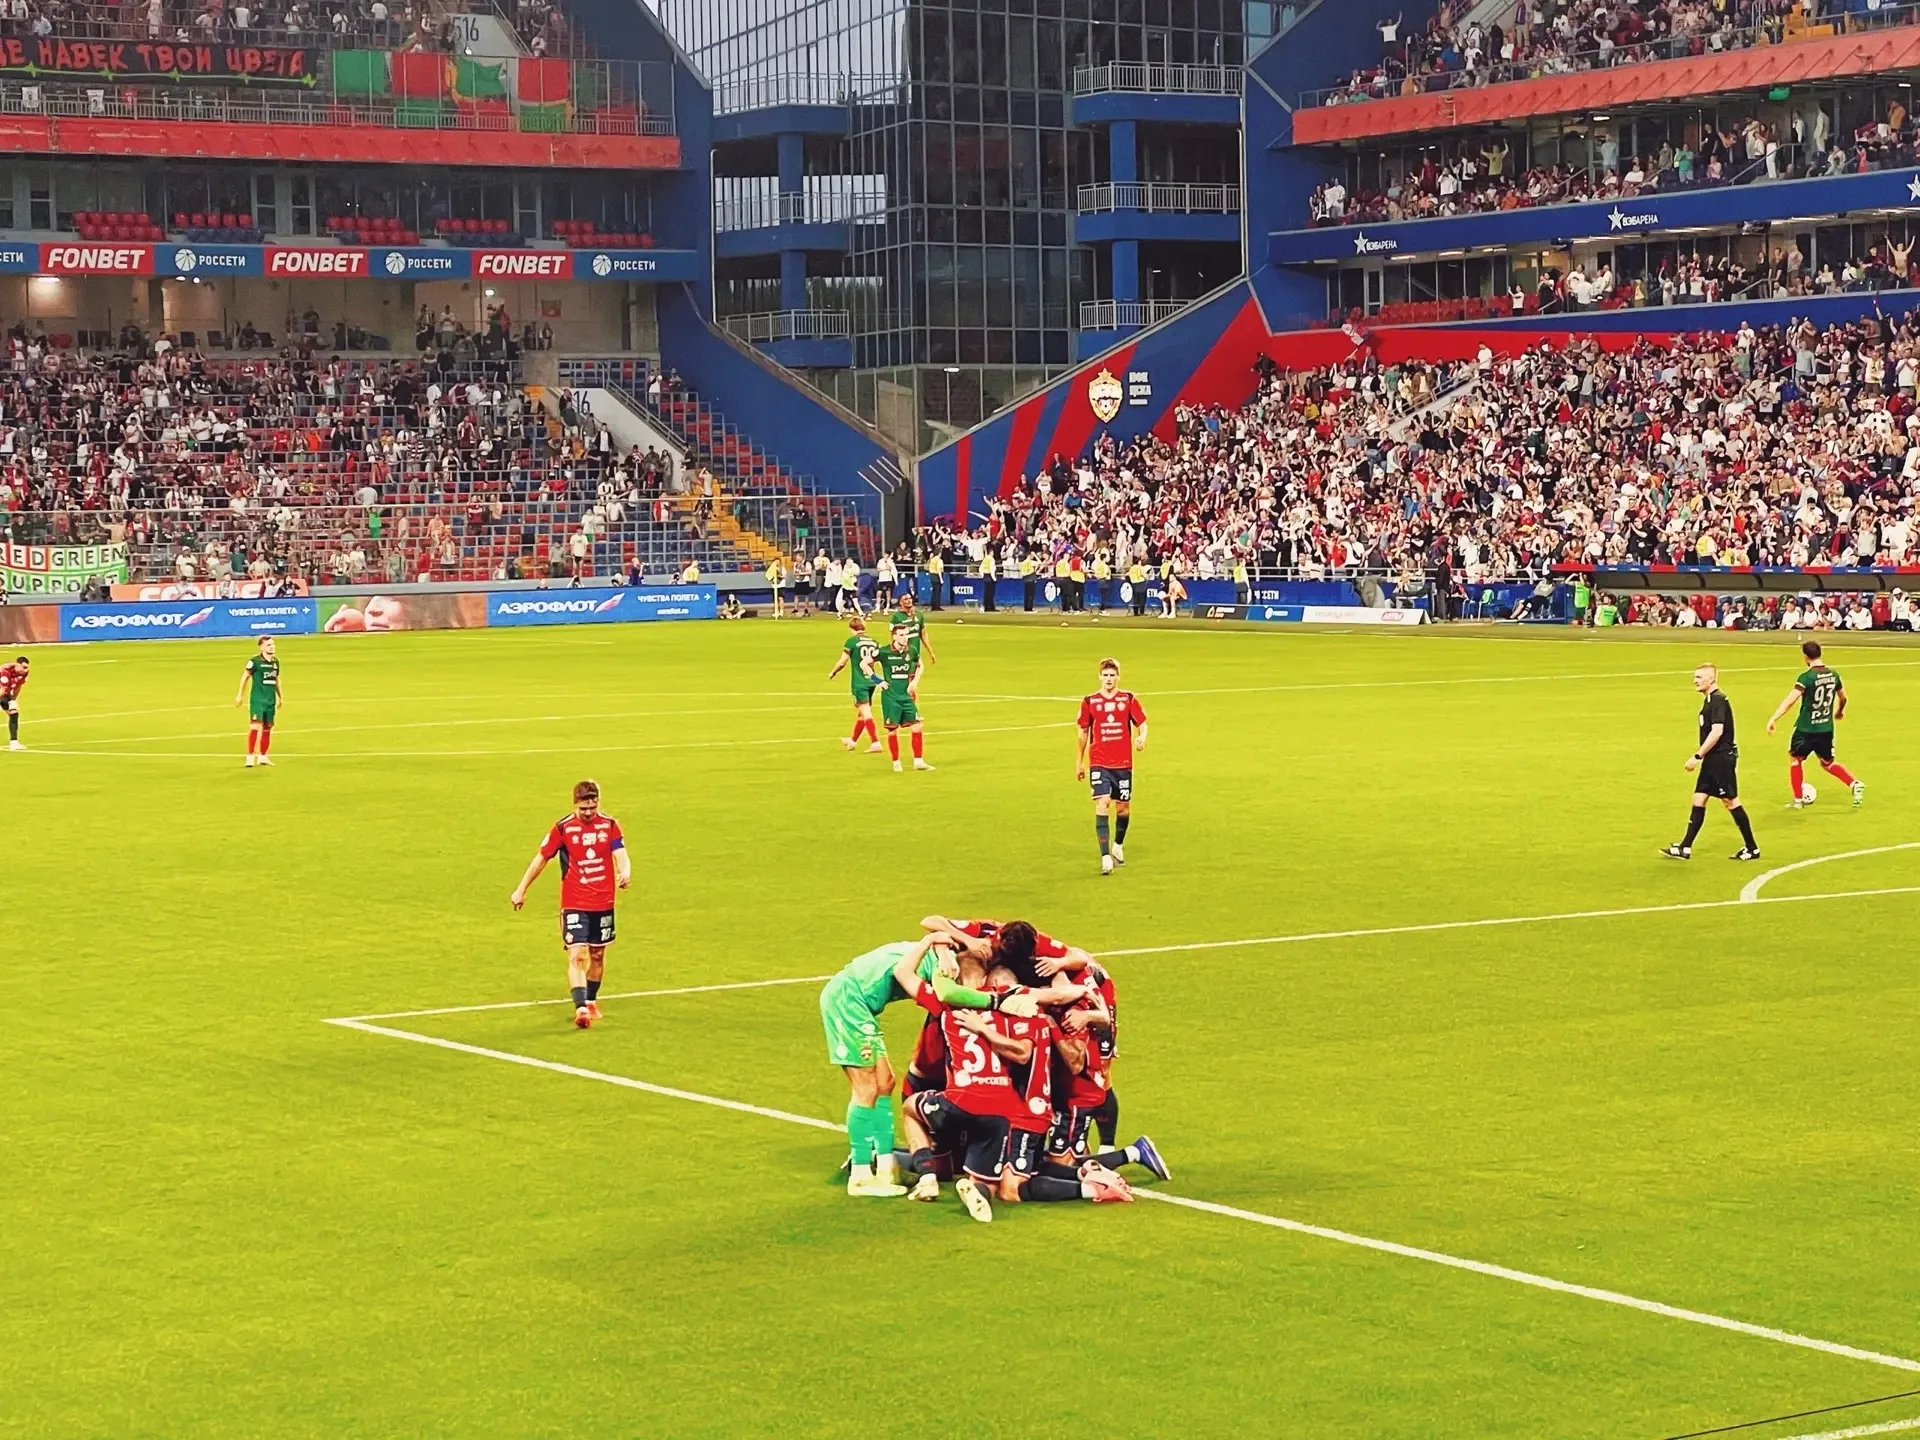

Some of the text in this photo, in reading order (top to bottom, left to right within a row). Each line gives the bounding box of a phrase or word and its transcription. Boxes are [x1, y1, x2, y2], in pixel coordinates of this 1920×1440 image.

[453, 16, 479, 41] 516
[37, 39, 128, 70] НАВЕК
[136, 44, 211, 72] ТВОИ
[226, 47, 304, 76] ЦВЕТА
[47, 248, 146, 269] FONBET
[199, 255, 246, 267] РОССЕТИ
[272, 252, 364, 273] FONBET
[407, 258, 452, 269] РОССЕТИ
[478, 255, 566, 274] FONBET
[613, 260, 656, 271] РОССЕТИ
[0, 571, 118, 592] UPPOT
[498, 600, 597, 614] АЭРОФЛОТ
[71, 613, 184, 628] АЭРОФЛОТ
[1812, 684, 1835, 709] 93
[601, 928, 611, 941] 10
